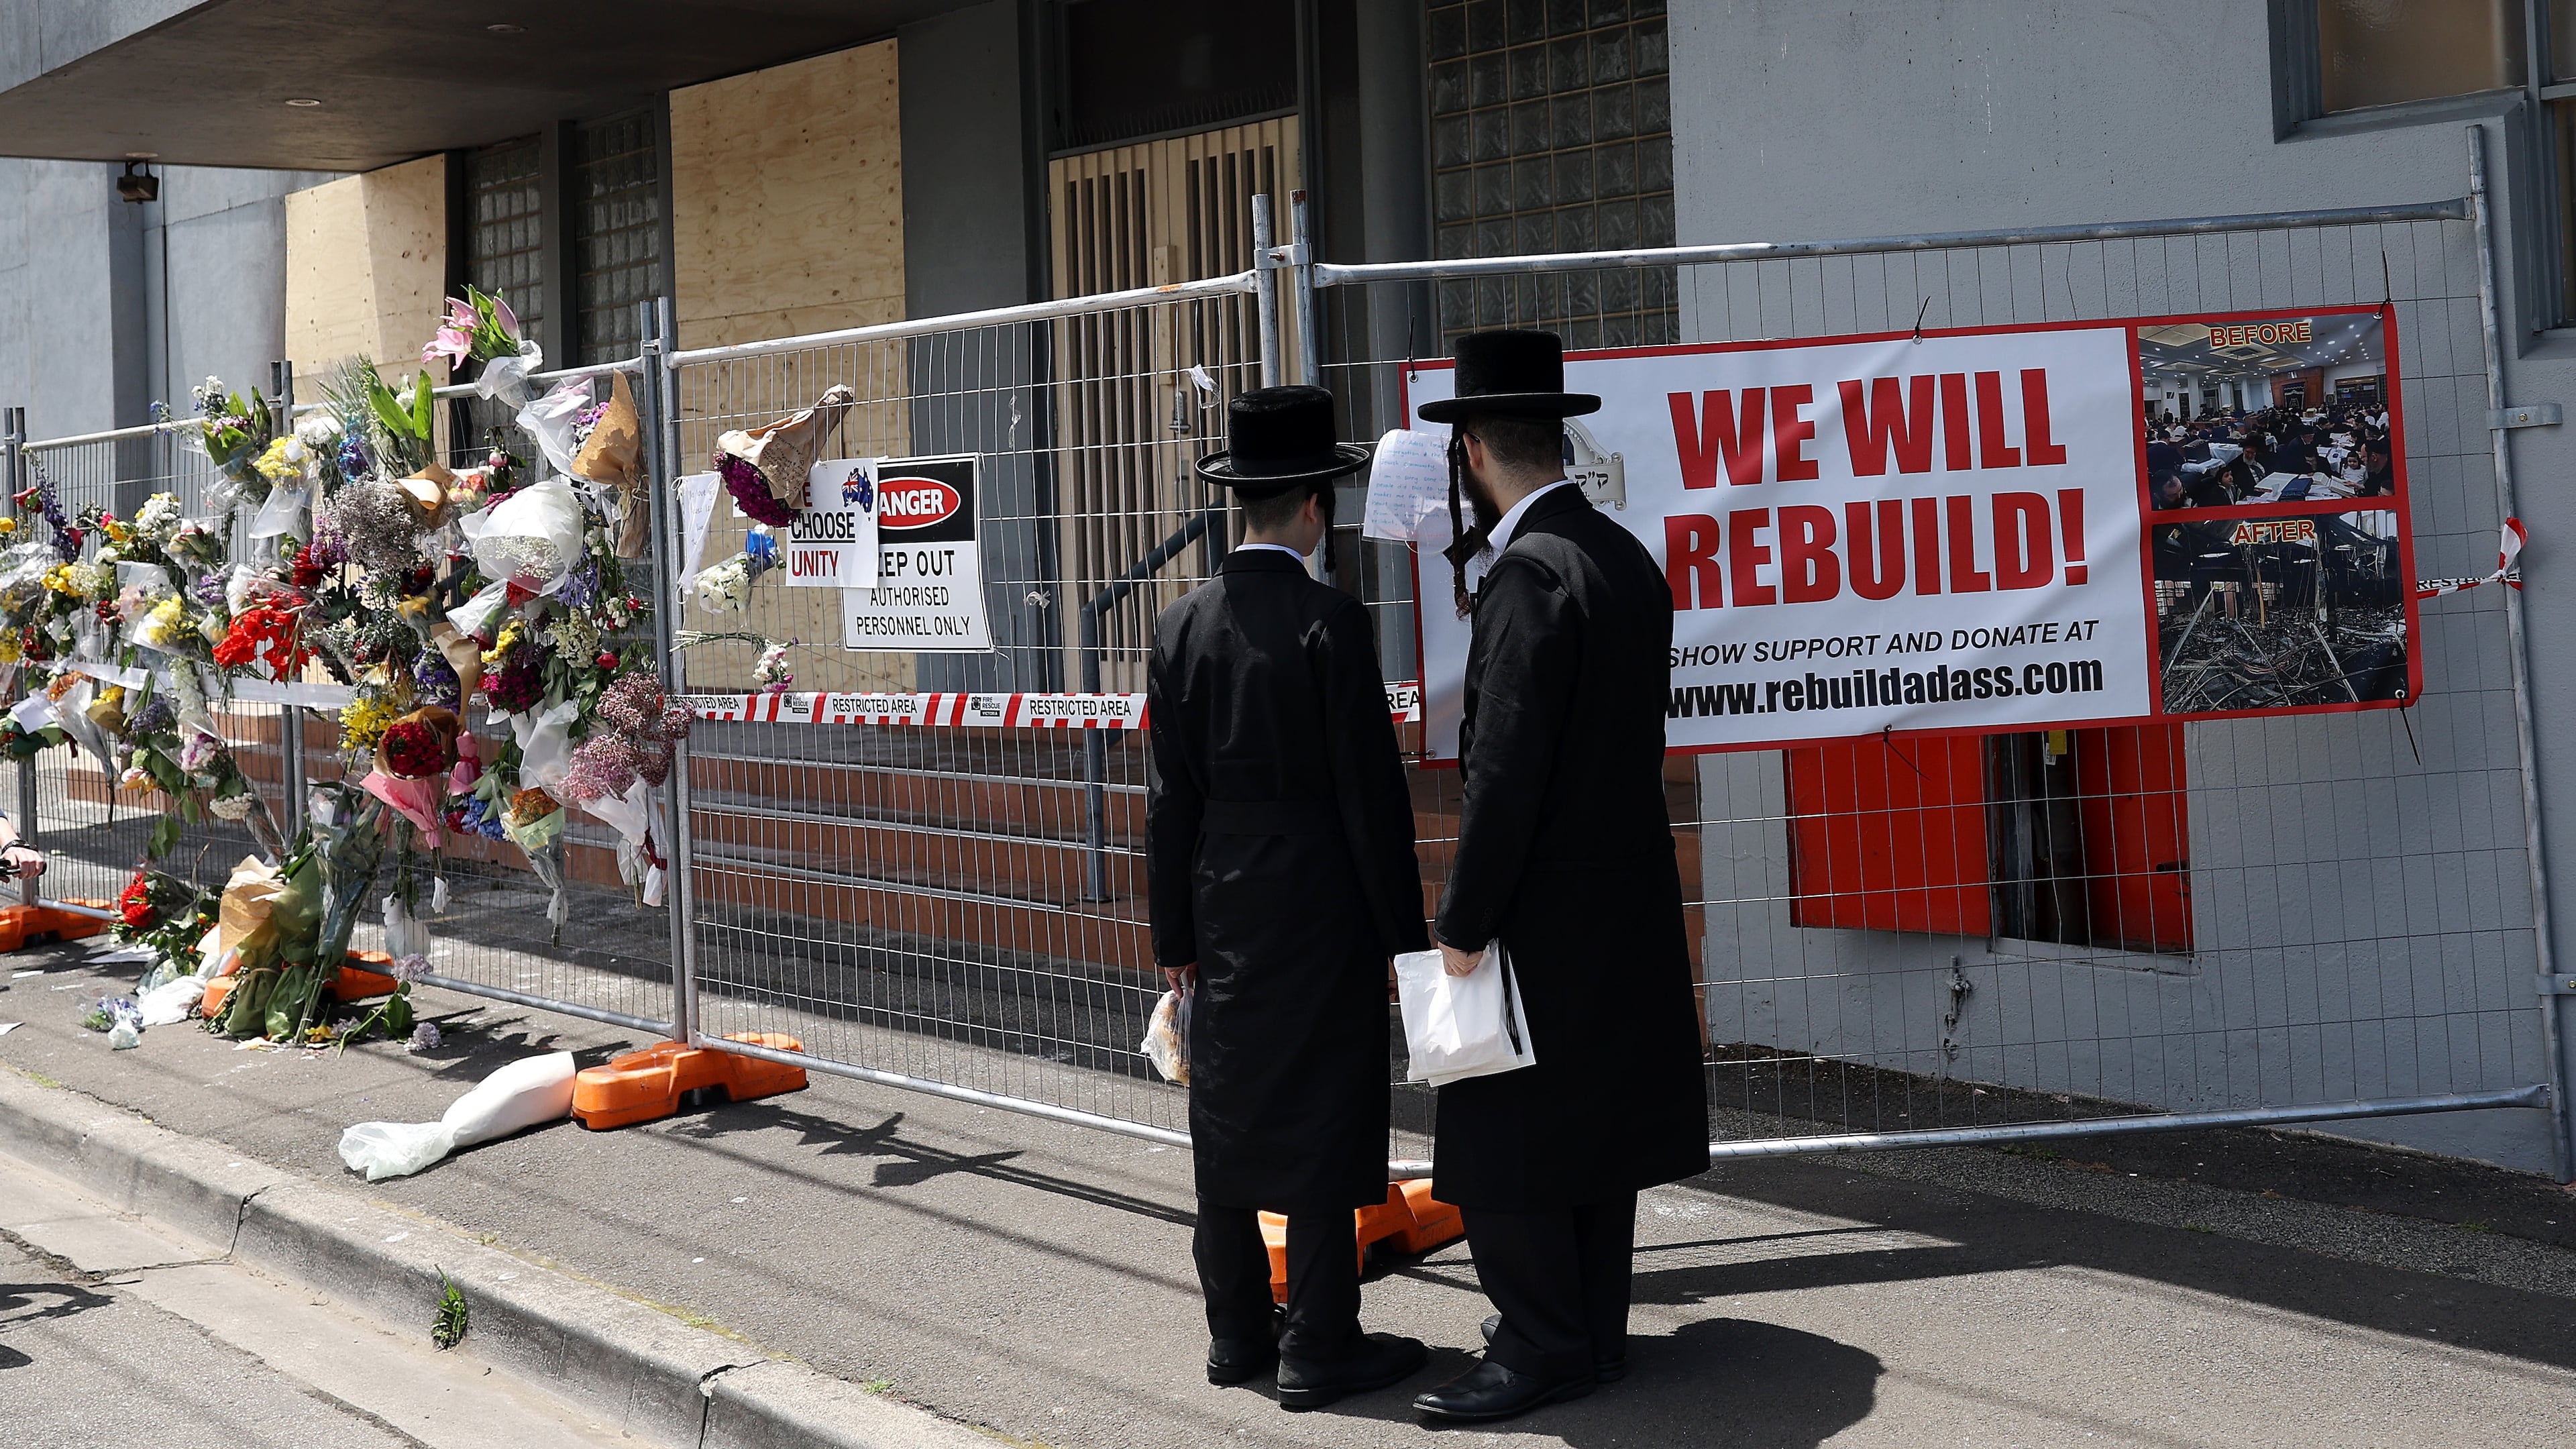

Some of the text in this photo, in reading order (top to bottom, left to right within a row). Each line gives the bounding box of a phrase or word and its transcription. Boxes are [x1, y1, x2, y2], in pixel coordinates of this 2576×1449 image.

[2210, 321, 2312, 347] BEFORE
[1667, 368, 2067, 490] WE WILL
[802, 482, 813, 507] E
[879, 488, 945, 517] ANGER
[791, 512, 855, 539] CHOOSE
[2234, 519, 2316, 545] AFTER
[1664, 488, 2088, 611] REBUILD!
[792, 550, 839, 577] UNITY
[916, 550, 955, 577] OUT
[870, 586, 949, 606] AUTHORISED
[857, 616, 970, 636] PERSONNEL ONLY
[1669, 620, 2100, 668] SHOW SUPPORT AND DONATE AT
[1387, 690, 1419, 709] REA
[1667, 658, 2104, 718] www.rebuildadass.com
[717, 697, 741, 710] AREA
[833, 698, 918, 714] RESTRICTED AREA
[1030, 700, 1132, 716] RESTRICTED AREA
